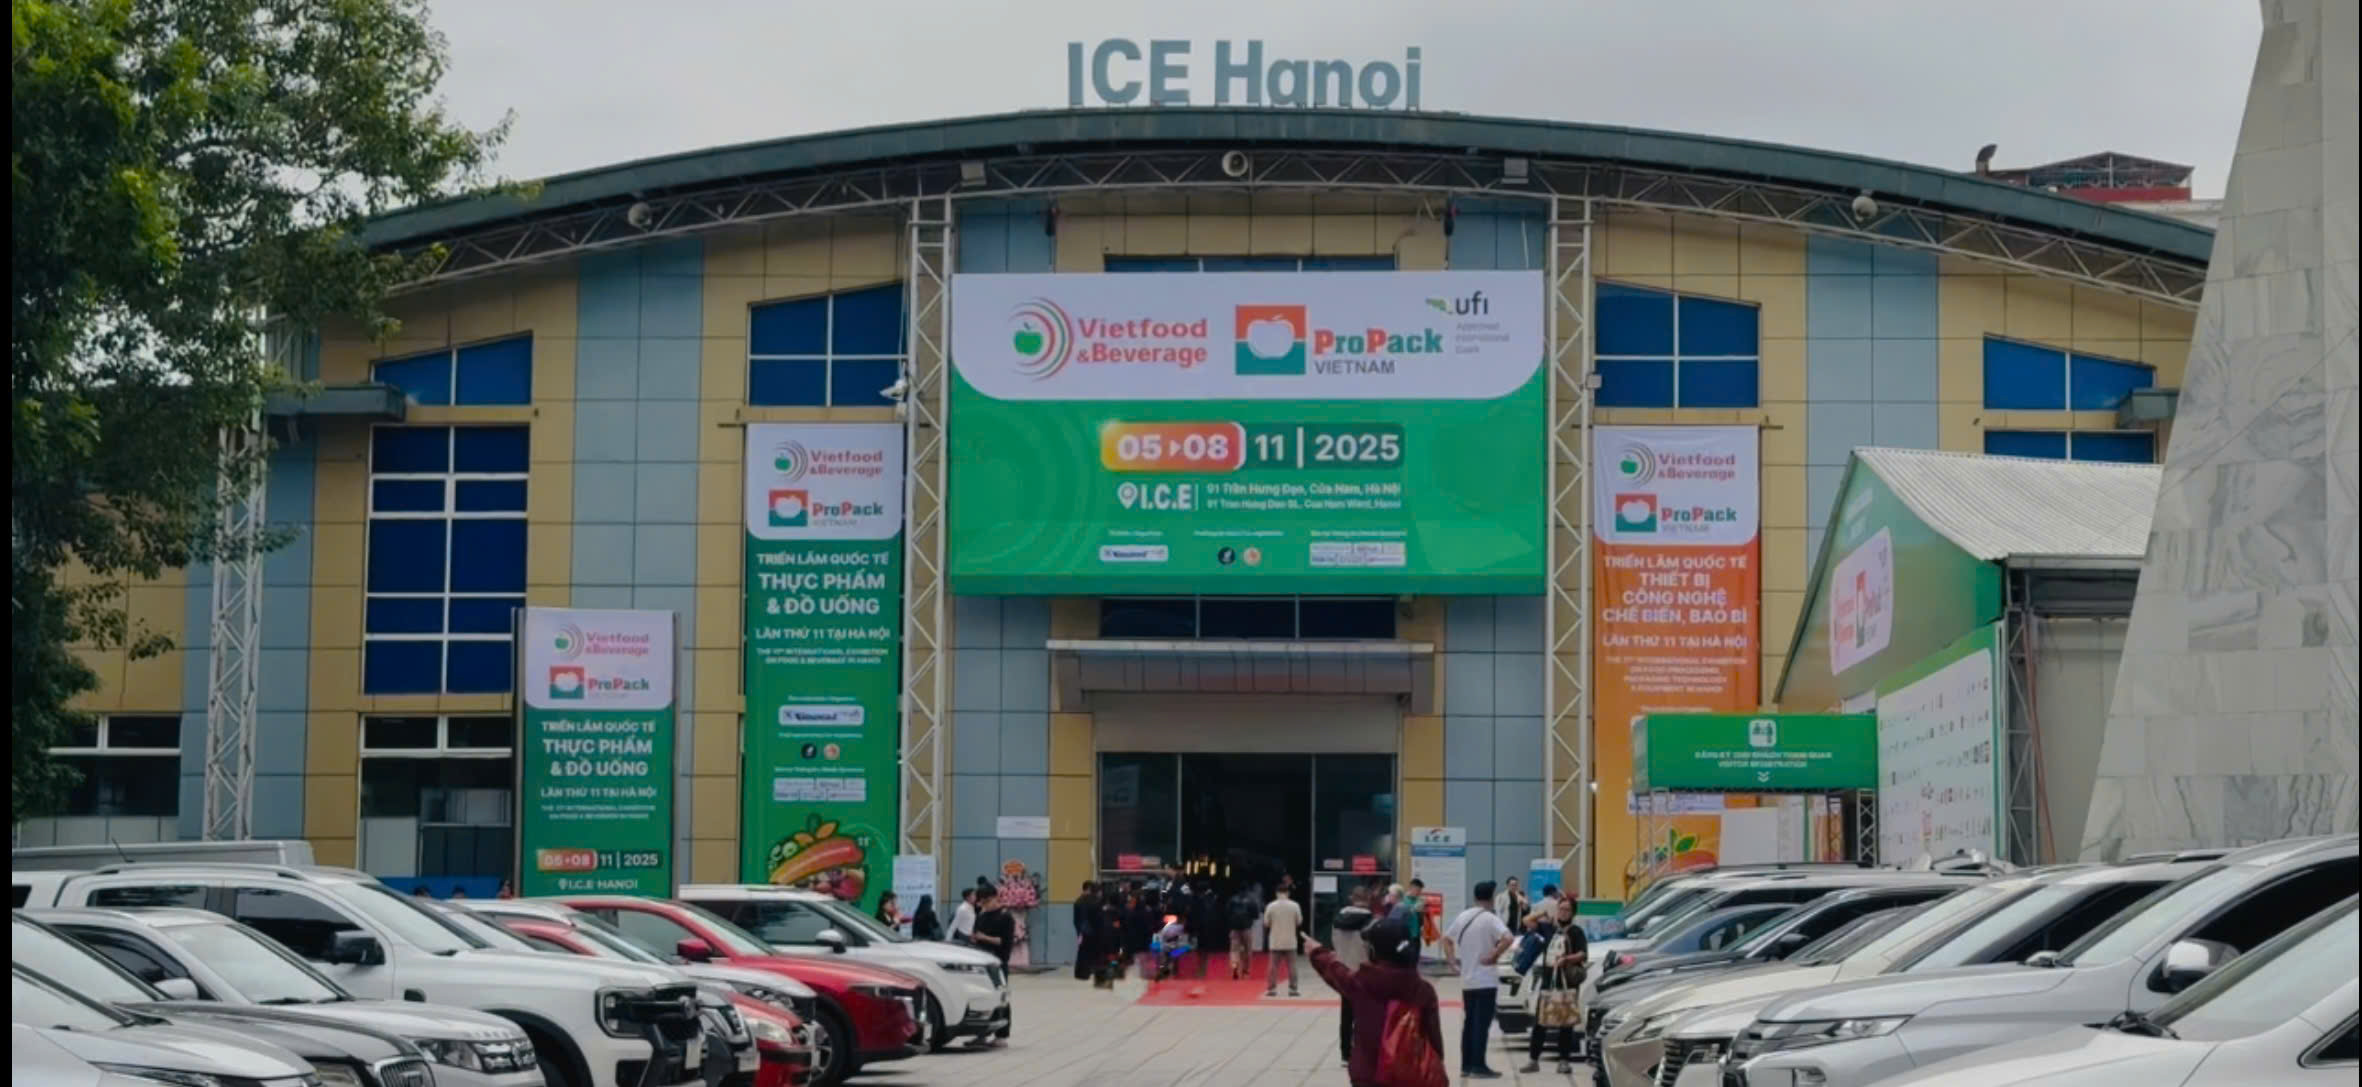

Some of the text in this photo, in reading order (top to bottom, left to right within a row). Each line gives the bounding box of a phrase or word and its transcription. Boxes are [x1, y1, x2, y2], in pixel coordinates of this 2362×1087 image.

[1068, 38, 1421, 111] ICE Hanoi
[1077, 318, 1207, 338] Vietfood
[1313, 328, 1444, 355] ProPack
[1076, 343, 1207, 368] &Beverage
[1314, 360, 1395, 375] VIETNAM
[1118, 434, 1400, 461] 05 08 11 2025
[810, 450, 882, 463] Vietfood
[1658, 453, 1735, 465] Vietfood
[812, 500, 883, 517] ProPack
[1661, 507, 1737, 521] ProPack
[758, 572, 818, 594] THỰC
[767, 592, 880, 615] & ĐỒ UỐNG
[1623, 588, 1673, 605] CÔNG
[1689, 609, 1727, 623] BAO
[586, 632, 649, 643] Vietfood
[588, 677, 649, 690] ProPack
[542, 738, 595, 757] THỰC
[551, 761, 562, 776] &
[601, 854, 612, 865] 11
[624, 854, 658, 866] 2025
[598, 879, 638, 889] HANOI
